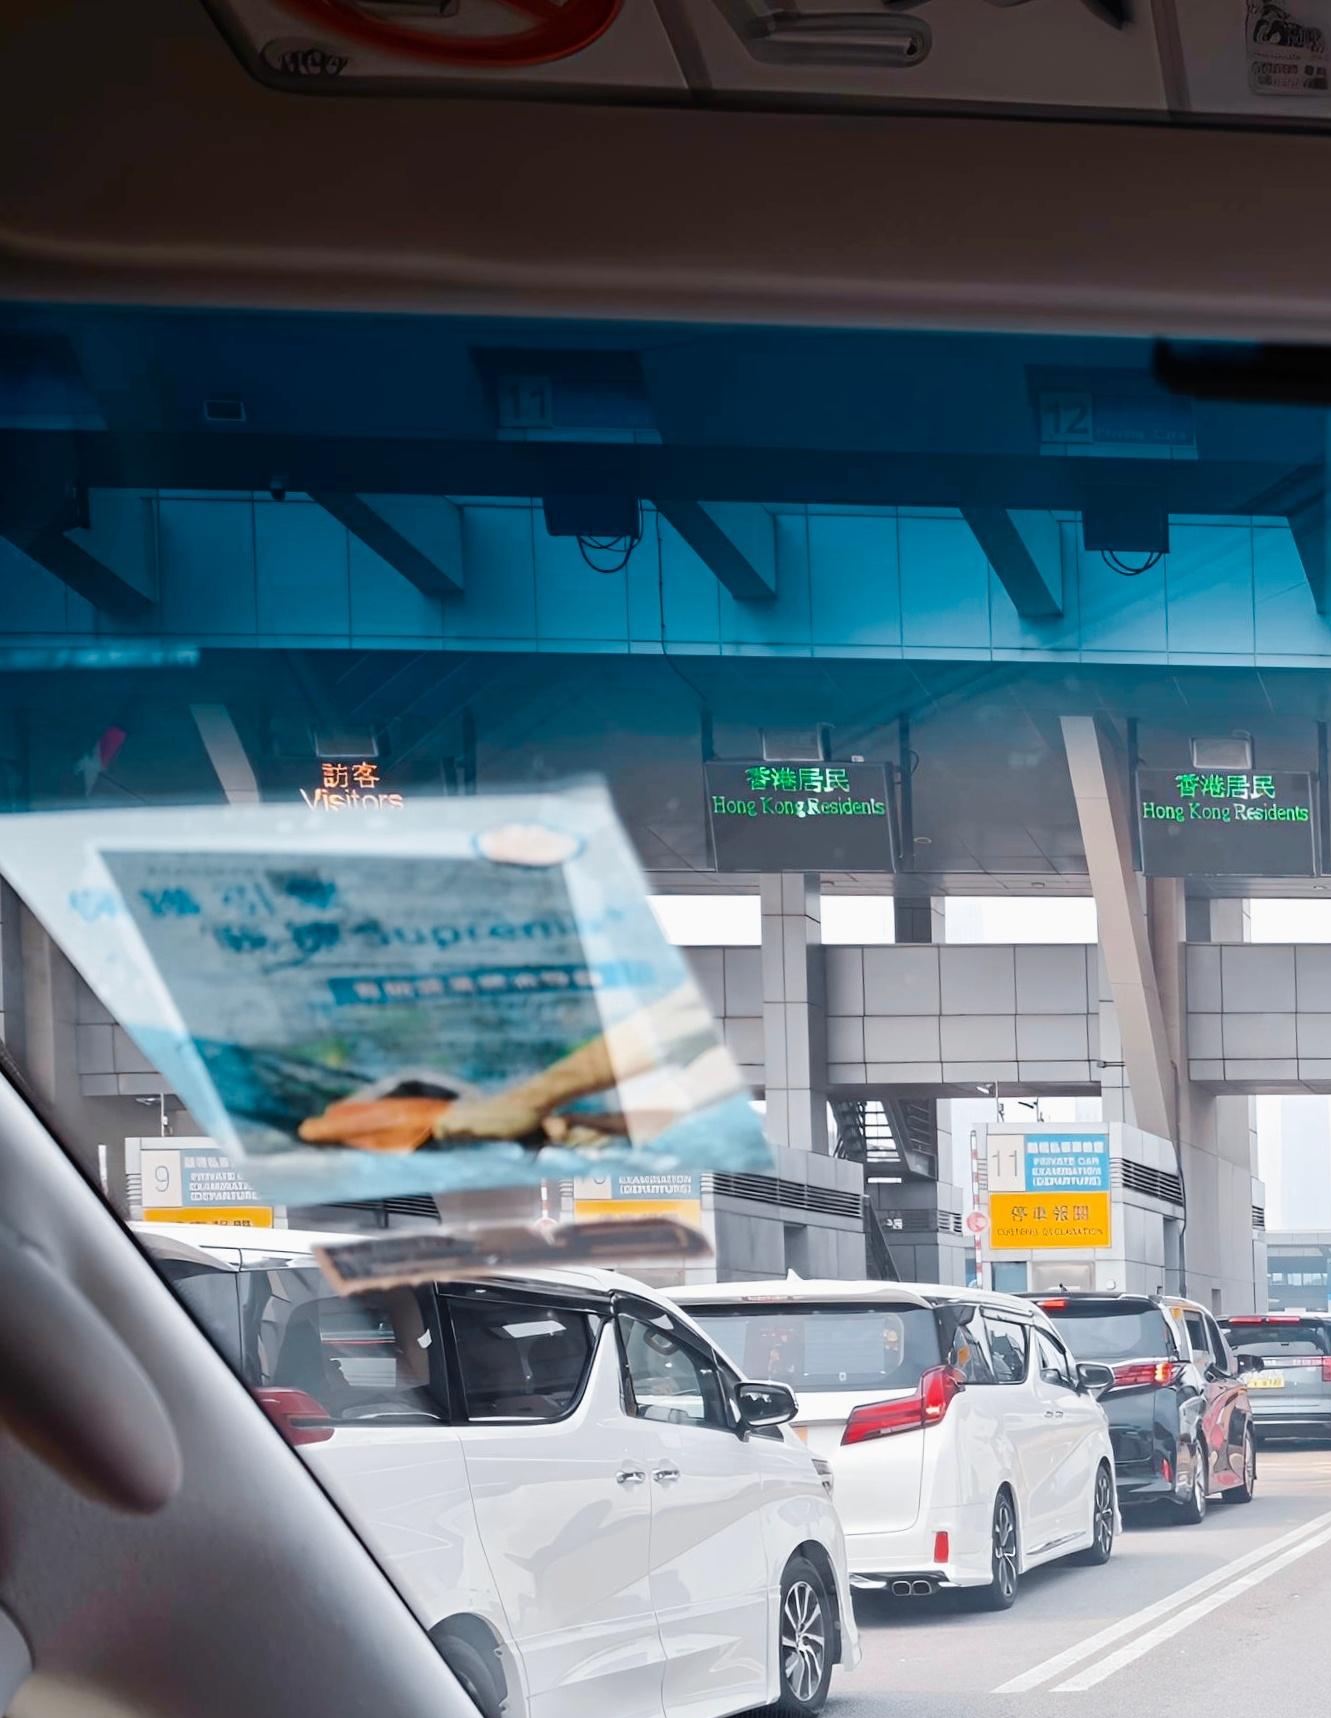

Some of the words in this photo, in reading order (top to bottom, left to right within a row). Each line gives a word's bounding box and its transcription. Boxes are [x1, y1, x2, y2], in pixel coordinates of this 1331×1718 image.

[1043, 399, 1088, 434] 12
[322, 761, 380, 788] 訪客
[745, 767, 849, 792] 香港居民
[1175, 774, 1276, 800] 香港居民
[299, 788, 404, 811] Visitors
[712, 796, 757, 816] Hong
[760, 797, 806, 817] Kong
[807, 798, 885, 815] Residents
[1143, 802, 1185, 822] Hong
[1189, 803, 1230, 822] Kong
[1233, 803, 1309, 821] Residents
[992, 1150, 1018, 1177] 11
[155, 1165, 170, 1192] 9
